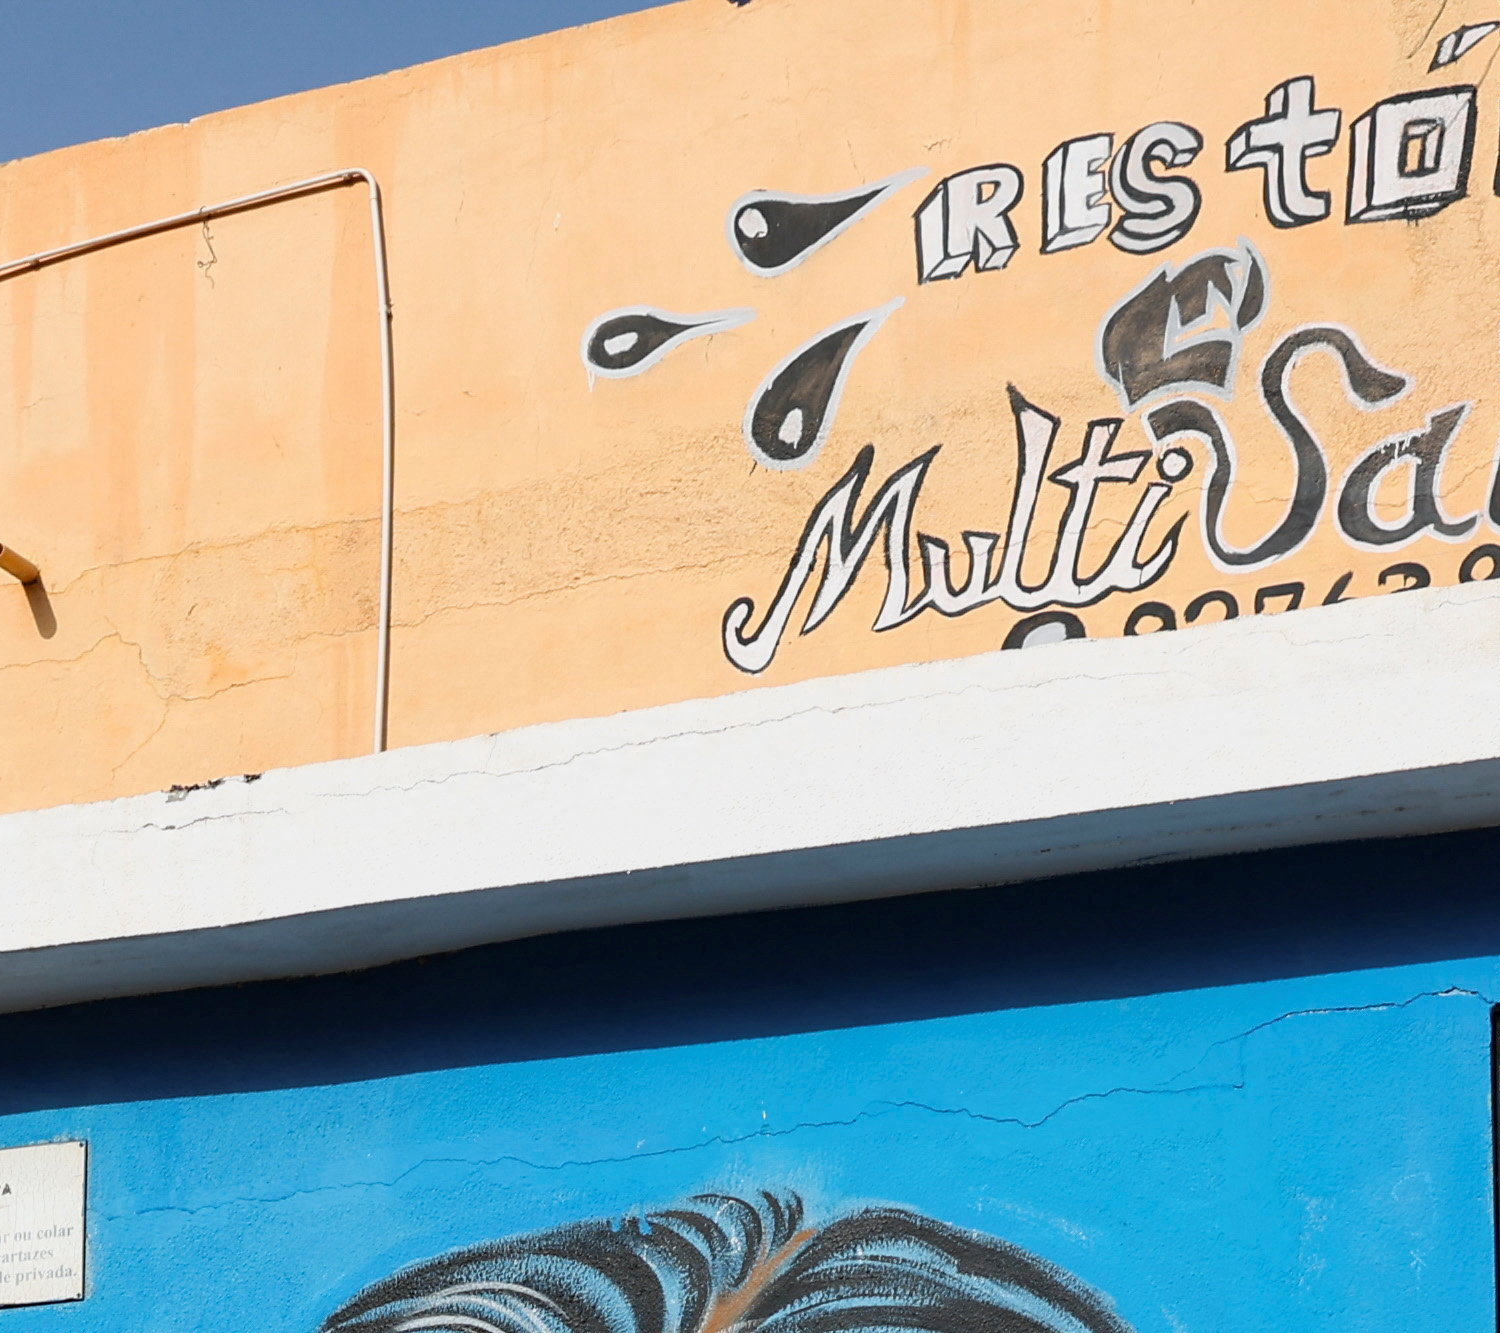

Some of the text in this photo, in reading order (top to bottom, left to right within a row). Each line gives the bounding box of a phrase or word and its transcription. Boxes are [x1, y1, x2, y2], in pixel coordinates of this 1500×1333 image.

[723, 382, 1193, 673] Multi
[14, 1230, 31, 1242] ou
[37, 1225, 74, 1240] colar
